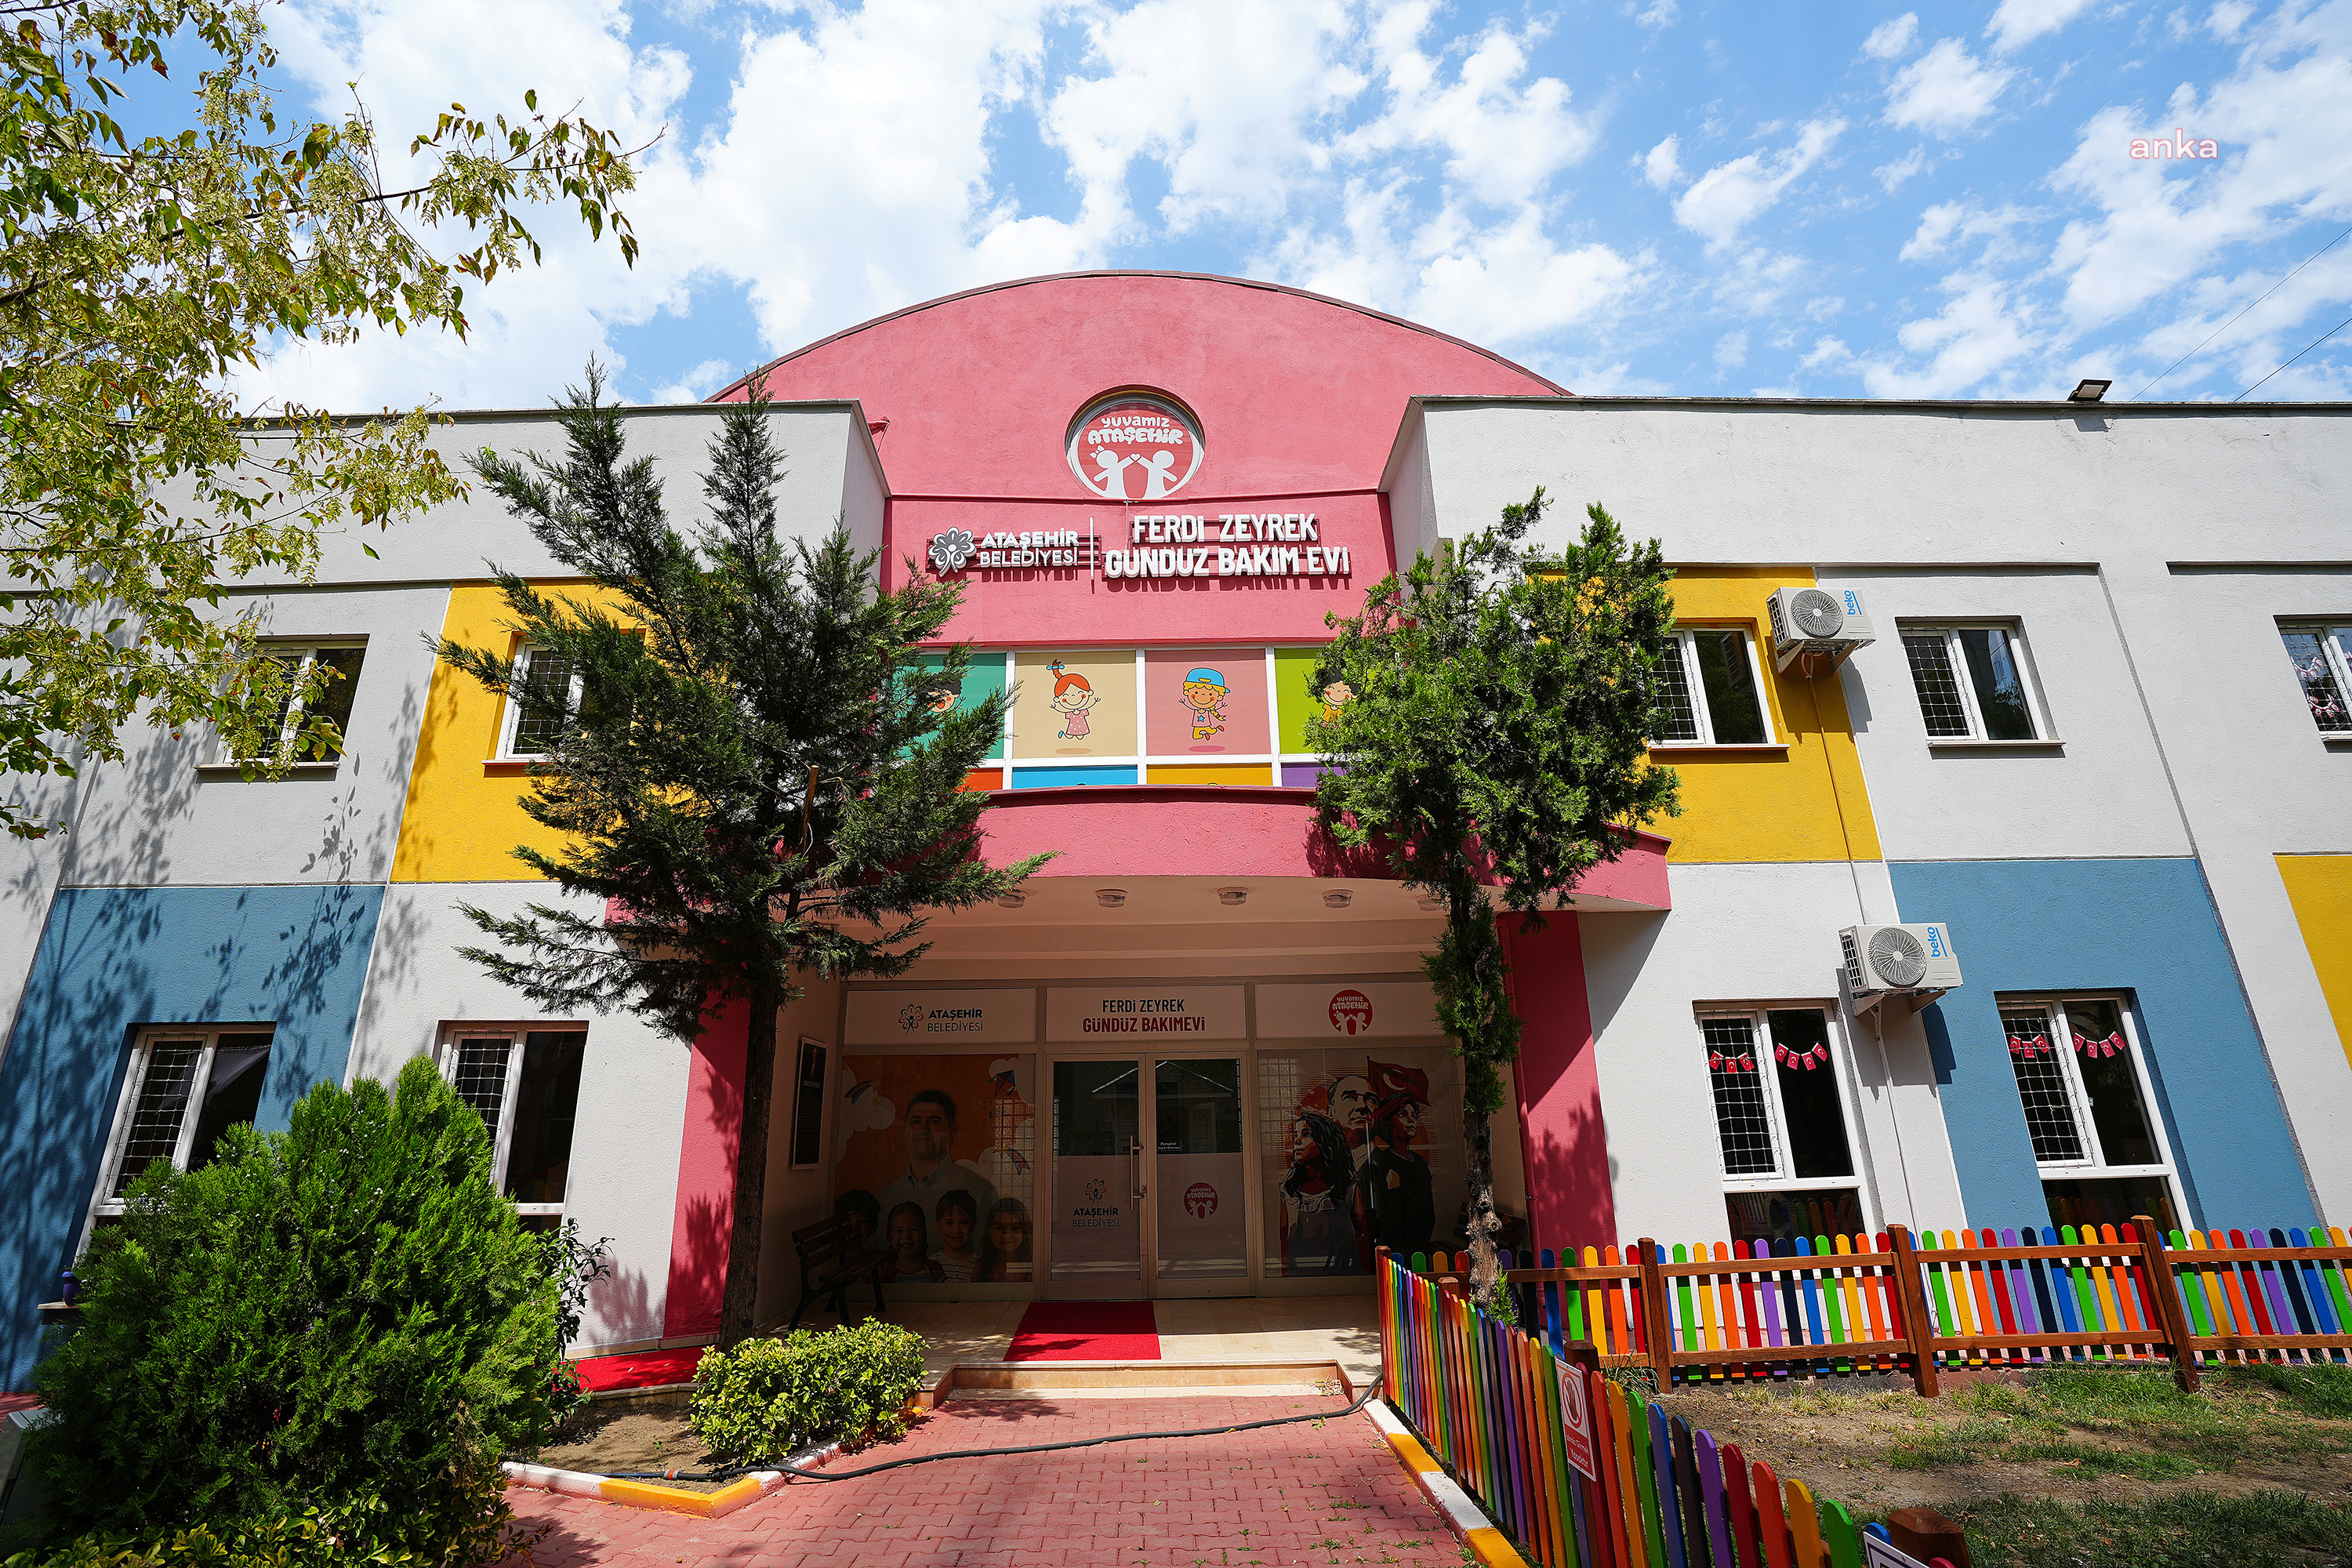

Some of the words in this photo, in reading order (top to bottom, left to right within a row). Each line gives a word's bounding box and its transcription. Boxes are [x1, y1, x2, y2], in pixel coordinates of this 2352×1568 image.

[1101, 416, 1171, 428] yuvamız
[1087, 426, 1184, 445] ATAŞEHİR
[1218, 513, 1318, 543] ZEYREK
[980, 527, 1080, 550] ATAŞEHİR
[979, 546, 1079, 568] BELEDİYESİ
[1218, 547, 1300, 577] BAKIM
[1305, 546, 1350, 575] EVİ
[1844, 590, 1856, 615] beko
[1927, 926, 1940, 957] beko
[928, 1007, 983, 1022] ATAŞEHİR
[1102, 1000, 1136, 1013] FERDİ
[1139, 999, 1185, 1012] ZEYREK
[927, 1020, 983, 1033] BELEDİYESİ
[1083, 1017, 1138, 1033] GÜNDÜZ
[1142, 1016, 1206, 1032] BAKIMEVİ
[1073, 1206, 1119, 1218] ATAŞEHİR
[1073, 1217, 1120, 1228] BELEDİYESİ
